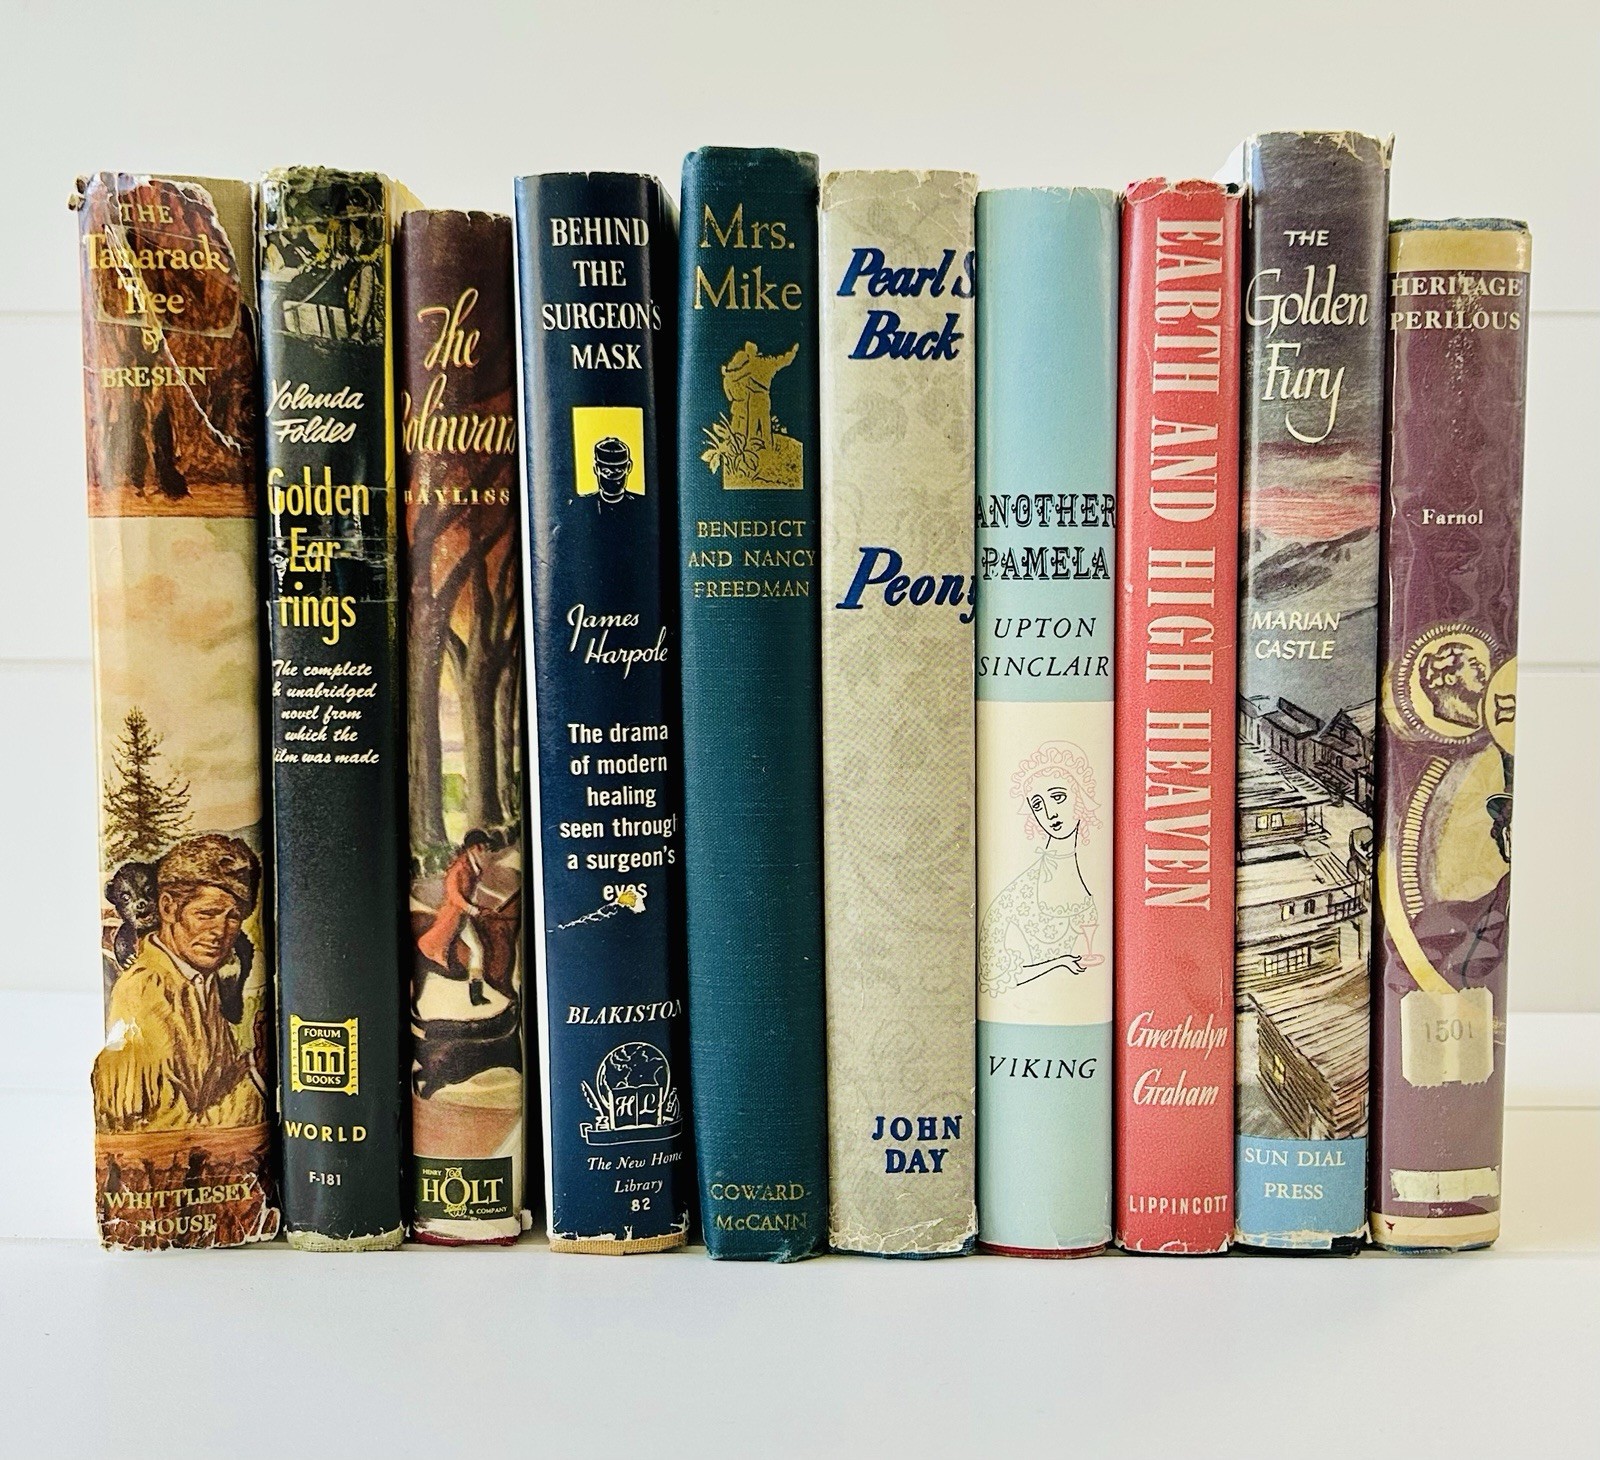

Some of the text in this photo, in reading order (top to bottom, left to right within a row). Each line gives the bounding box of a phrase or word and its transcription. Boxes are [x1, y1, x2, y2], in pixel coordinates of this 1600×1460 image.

[121, 202, 173, 224] THE
[551, 217, 650, 247] BEHIND
[700, 203, 795, 250] Mrs.
[1283, 230, 1329, 247] THE
[83, 233, 230, 273] Tamarack
[573, 260, 627, 287] THE
[836, 247, 956, 298] Pearl
[117, 276, 185, 314] Tree
[693, 265, 802, 310] Mike
[1391, 276, 1523, 298] HERITAGE
[1245, 264, 1369, 339] Golden
[541, 299, 662, 331] SURGEON'S
[1390, 309, 1522, 331] PERILOUS
[417, 287, 481, 371] The
[848, 310, 965, 361] Buck
[571, 343, 643, 370] MASK
[102, 366, 207, 388] BRESLIN
[265, 379, 365, 417] Yolanda
[1261, 342, 1345, 444] Fury
[272, 415, 357, 444] Foldes
[267, 466, 370, 516] Golden
[975, 494, 1116, 528] ANOTHER
[1421, 509, 1484, 525] Farnol
[697, 520, 806, 538] BENEDICT
[289, 527, 342, 573] Ear
[688, 549, 816, 568] AND NANCY
[981, 546, 1111, 580] PAMELA
[1144, 217, 1224, 911] EARTH AND HIGH HEAVEN
[694, 580, 809, 598] FREEDMAN
[279, 581, 357, 646] rings
[1251, 611, 1341, 631] MARIAN
[566, 604, 639, 651] James
[994, 617, 1097, 638] UPTON
[585, 626, 668, 679] Harpole
[1255, 640, 1335, 660] CASTLE
[272, 659, 372, 680] The complete
[978, 656, 1110, 677] SINCLAIR
[272, 681, 378, 703] & unabridged
[281, 705, 362, 724] novel from
[284, 726, 358, 741] which the
[568, 723, 668, 744] The drama
[301, 752, 331, 763] was
[334, 749, 380, 764] made
[570, 755, 668, 775] of modern
[586, 786, 656, 808] healing
[559, 822, 604, 839] seen
[567, 845, 676, 873] a surgeon's
[603, 882, 648, 902] eyes
[304, 1027, 341, 1038] FORUM
[1126, 1010, 1228, 1060] Gwethalyn
[1424, 1018, 1474, 1044] 1501
[988, 1056, 1098, 1079] VIKING
[306, 1075, 342, 1085] BOOKS
[1133, 1068, 1219, 1107] Graham
[285, 1121, 368, 1142] WORLD
[872, 1115, 962, 1141] JOHN
[587, 1157, 612, 1171] The
[616, 1156, 646, 1169] New
[885, 1148, 949, 1174] DAY
[1245, 1148, 1346, 1167] SUN DIAL
[309, 1171, 341, 1185] F-181
[614, 1179, 664, 1194] Library
[104, 1182, 253, 1209] WHITTLESEY
[422, 1178, 503, 1204] HOLT
[1264, 1182, 1324, 1200] PRESS
[476, 1206, 508, 1214] COMPANY
[631, 1197, 651, 1212] 82
[1129, 1194, 1228, 1215] LIPPINCOTT
[138, 1213, 217, 1237] HOUSE
[716, 1213, 808, 1231] McCANN
